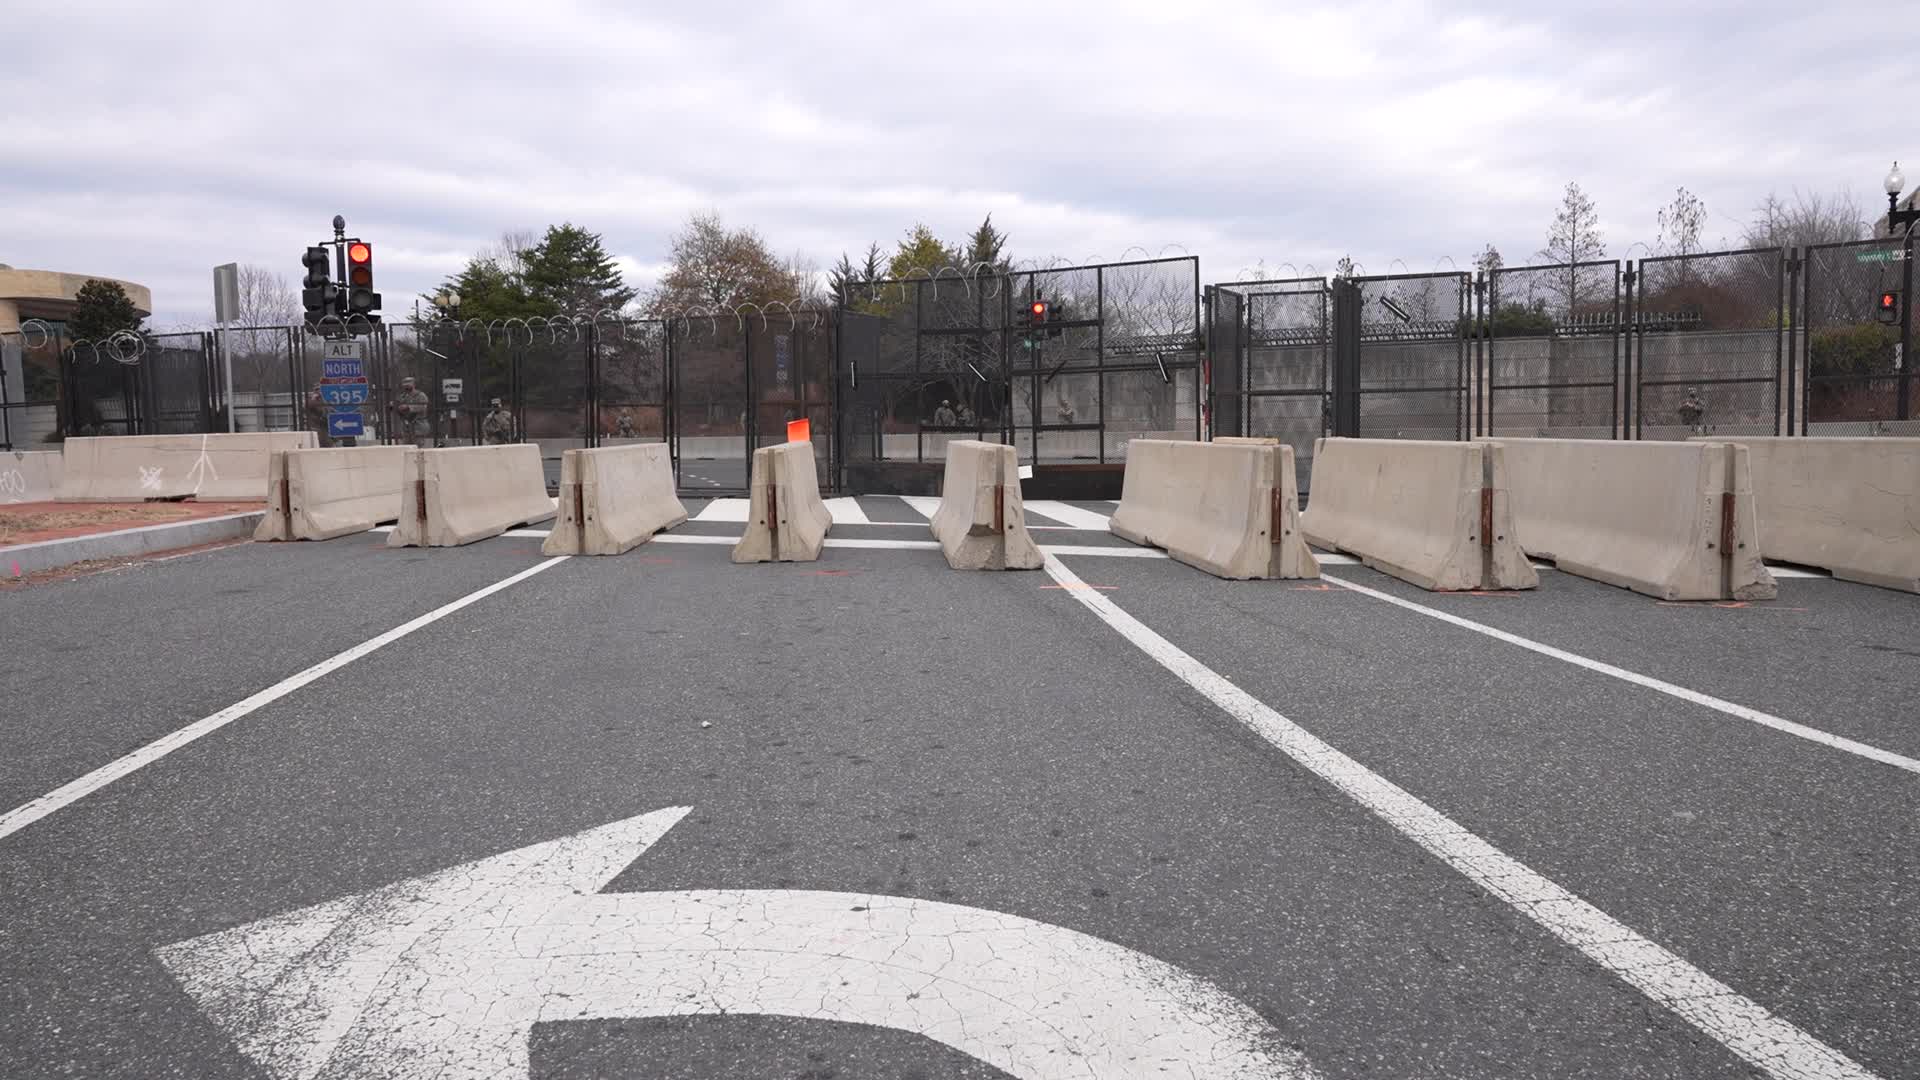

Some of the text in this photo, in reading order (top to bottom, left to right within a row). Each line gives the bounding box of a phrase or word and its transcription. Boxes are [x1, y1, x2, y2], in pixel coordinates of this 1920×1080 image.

[332, 345, 352, 355] ALT
[326, 363, 360, 374] NORTH
[330, 390, 362, 404] 395
